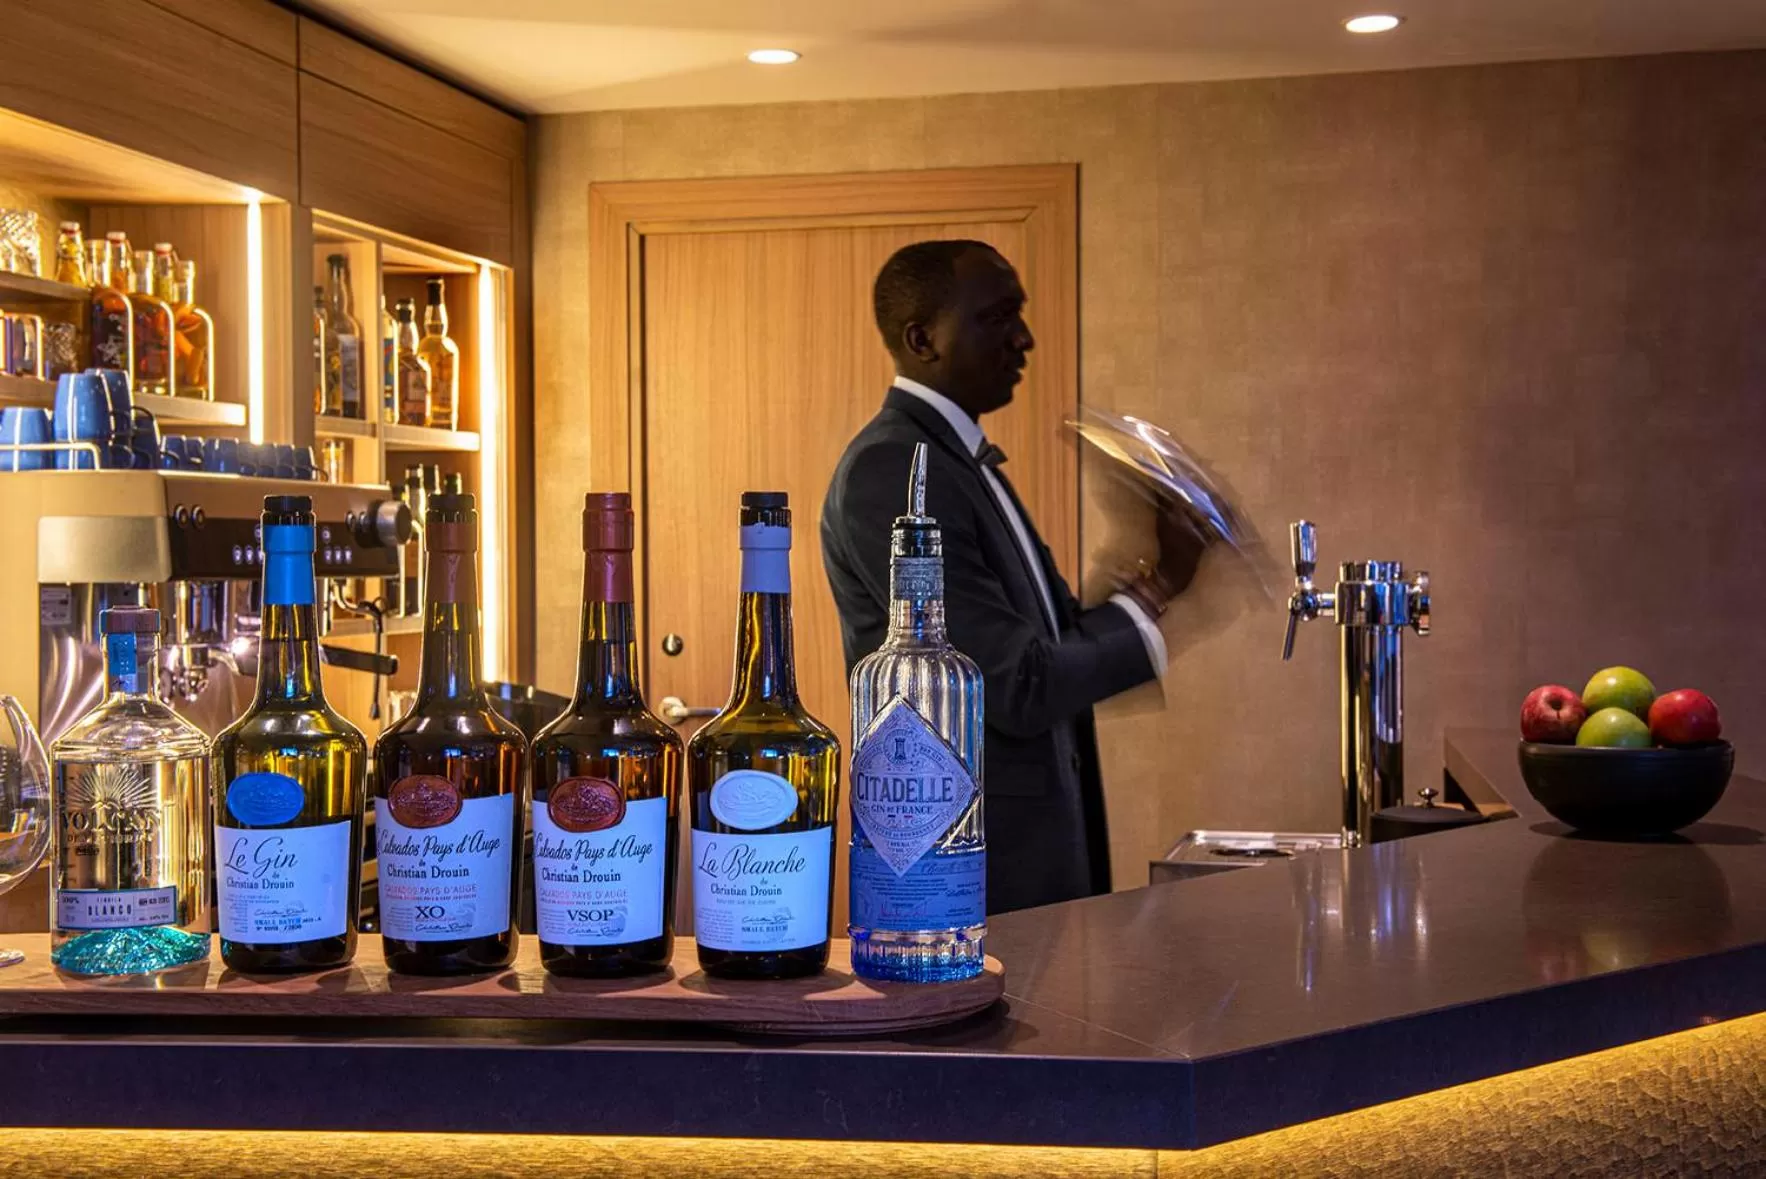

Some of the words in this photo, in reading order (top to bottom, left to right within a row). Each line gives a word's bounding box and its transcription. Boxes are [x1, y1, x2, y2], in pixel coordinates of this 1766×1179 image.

[856, 772, 953, 802] CITADELLE
[896, 804, 934, 814] FRANCE
[423, 836, 455, 862] Pays
[456, 830, 500, 858] d'Auge
[575, 839, 604, 867] Pays
[607, 834, 653, 863] d'Auge
[224, 836, 249, 875] Le
[252, 836, 298, 879] Gin
[698, 841, 719, 878] La
[721, 843, 806, 880] Blanche
[387, 862, 427, 878] Christian
[431, 864, 470, 878] Drouin
[542, 866, 579, 882] Christian
[583, 868, 621, 883] Drouin
[226, 876, 259, 889] Christian
[262, 877, 294, 889] Drouin
[710, 882, 747, 896] Christian
[750, 884, 782, 896] Drouin
[88, 904, 132, 917] BLANCO
[415, 905, 446, 919] XO
[567, 909, 614, 922] VSOP
